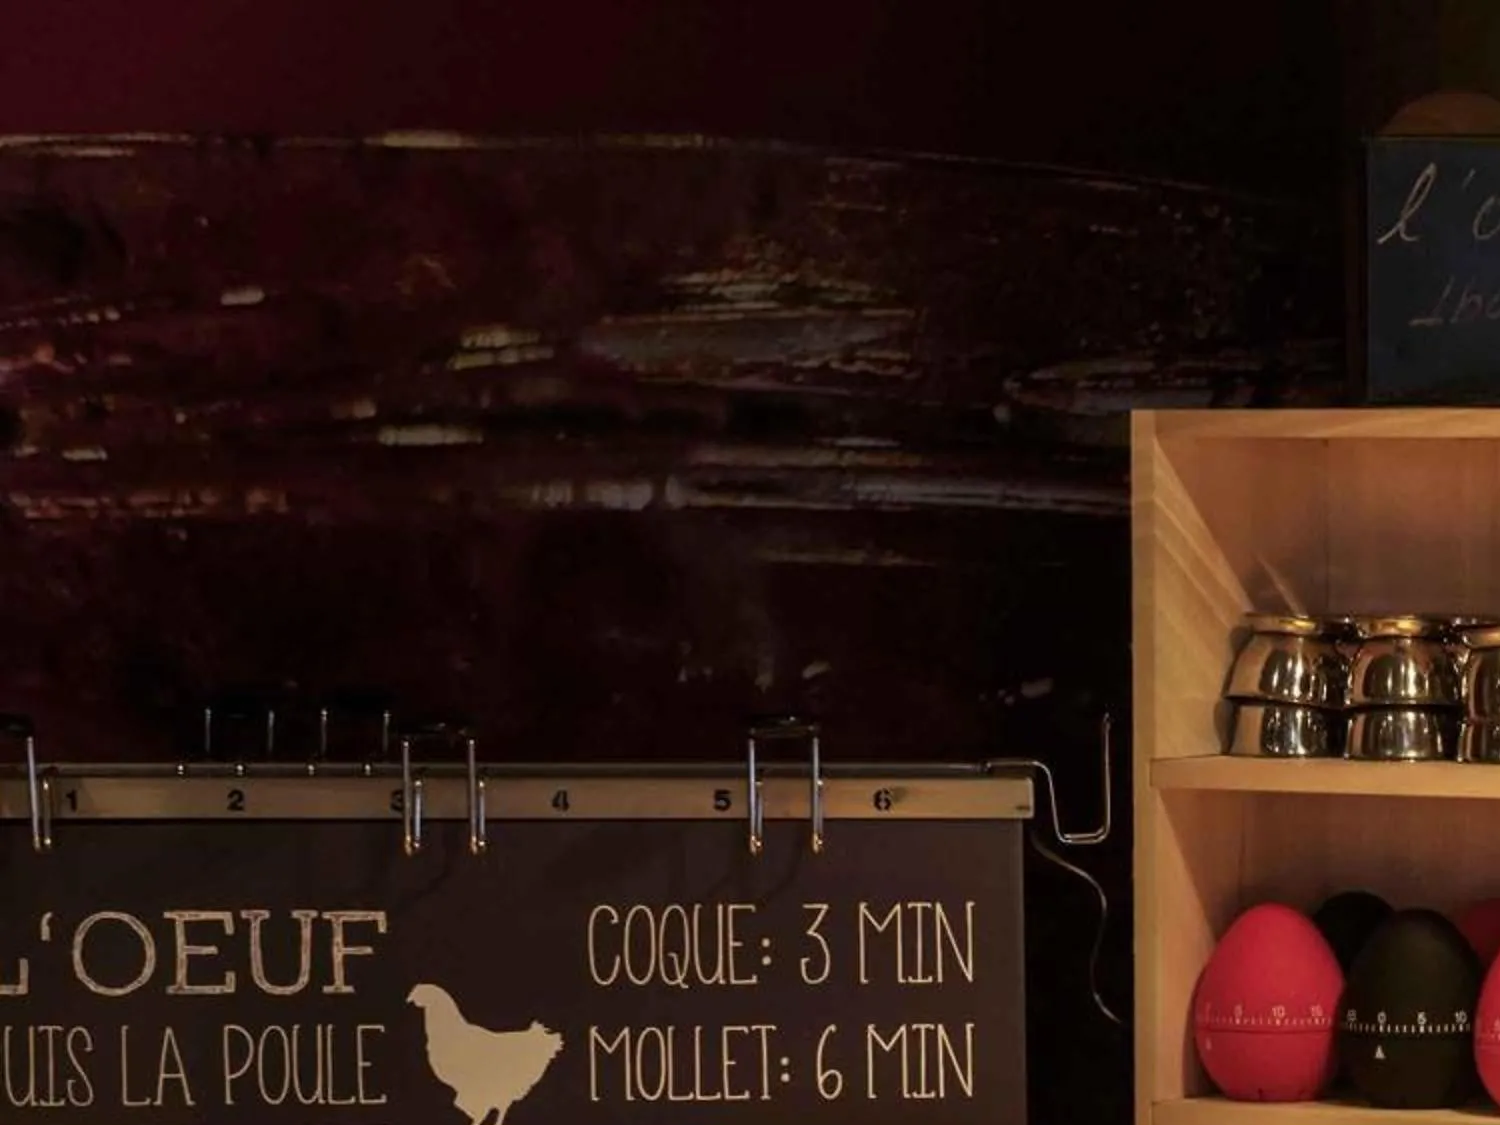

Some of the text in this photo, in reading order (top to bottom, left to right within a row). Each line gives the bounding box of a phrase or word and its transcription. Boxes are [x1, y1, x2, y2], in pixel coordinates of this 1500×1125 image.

[66, 791, 78, 811] 1
[227, 791, 246, 811] 2
[552, 789, 570, 811] 4
[713, 789, 733, 812] 5
[873, 789, 893, 812] 6
[588, 901, 976, 989] COQUE: 3 MIN
[121, 1025, 195, 1107] LA
[223, 1024, 388, 1106] POULE
[590, 1023, 976, 1102] MOLLET: 6 MIN
